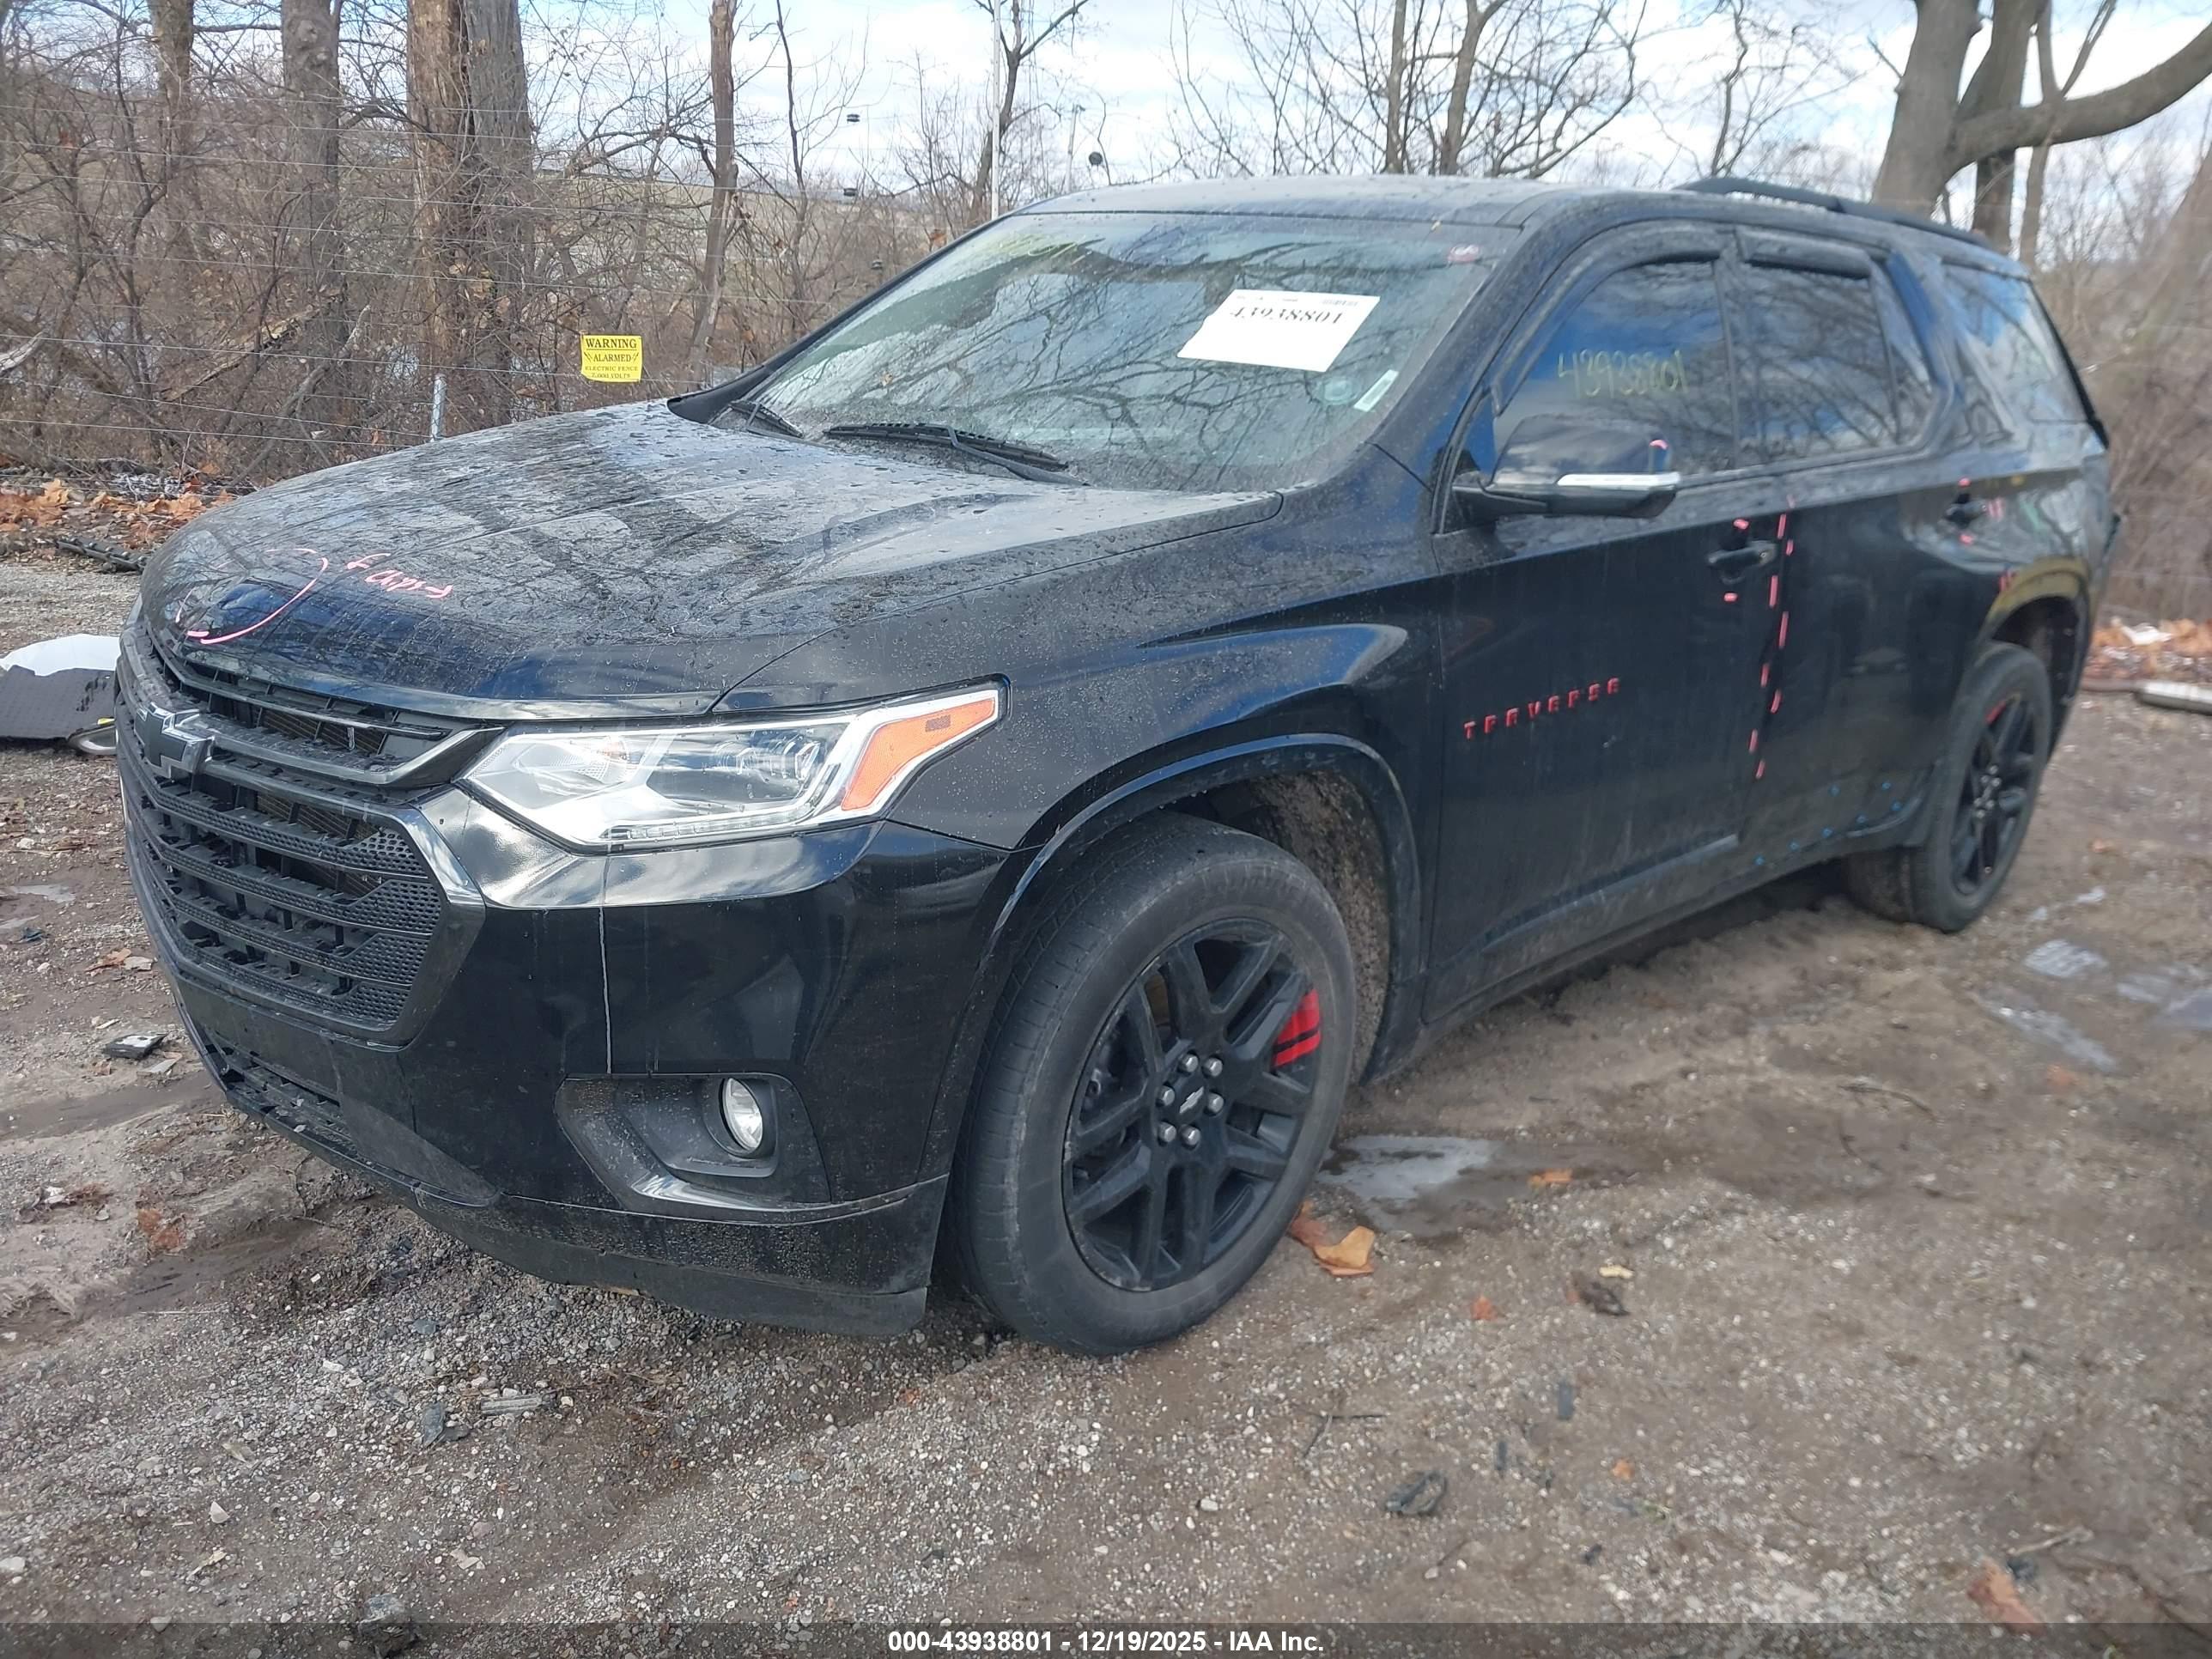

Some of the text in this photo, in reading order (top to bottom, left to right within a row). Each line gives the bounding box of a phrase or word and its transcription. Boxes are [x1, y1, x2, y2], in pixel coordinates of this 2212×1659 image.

[585, 337, 637, 349] WARNING
[592, 353, 632, 362] ALARMED
[1463, 677, 1621, 739] TRAVERSE
